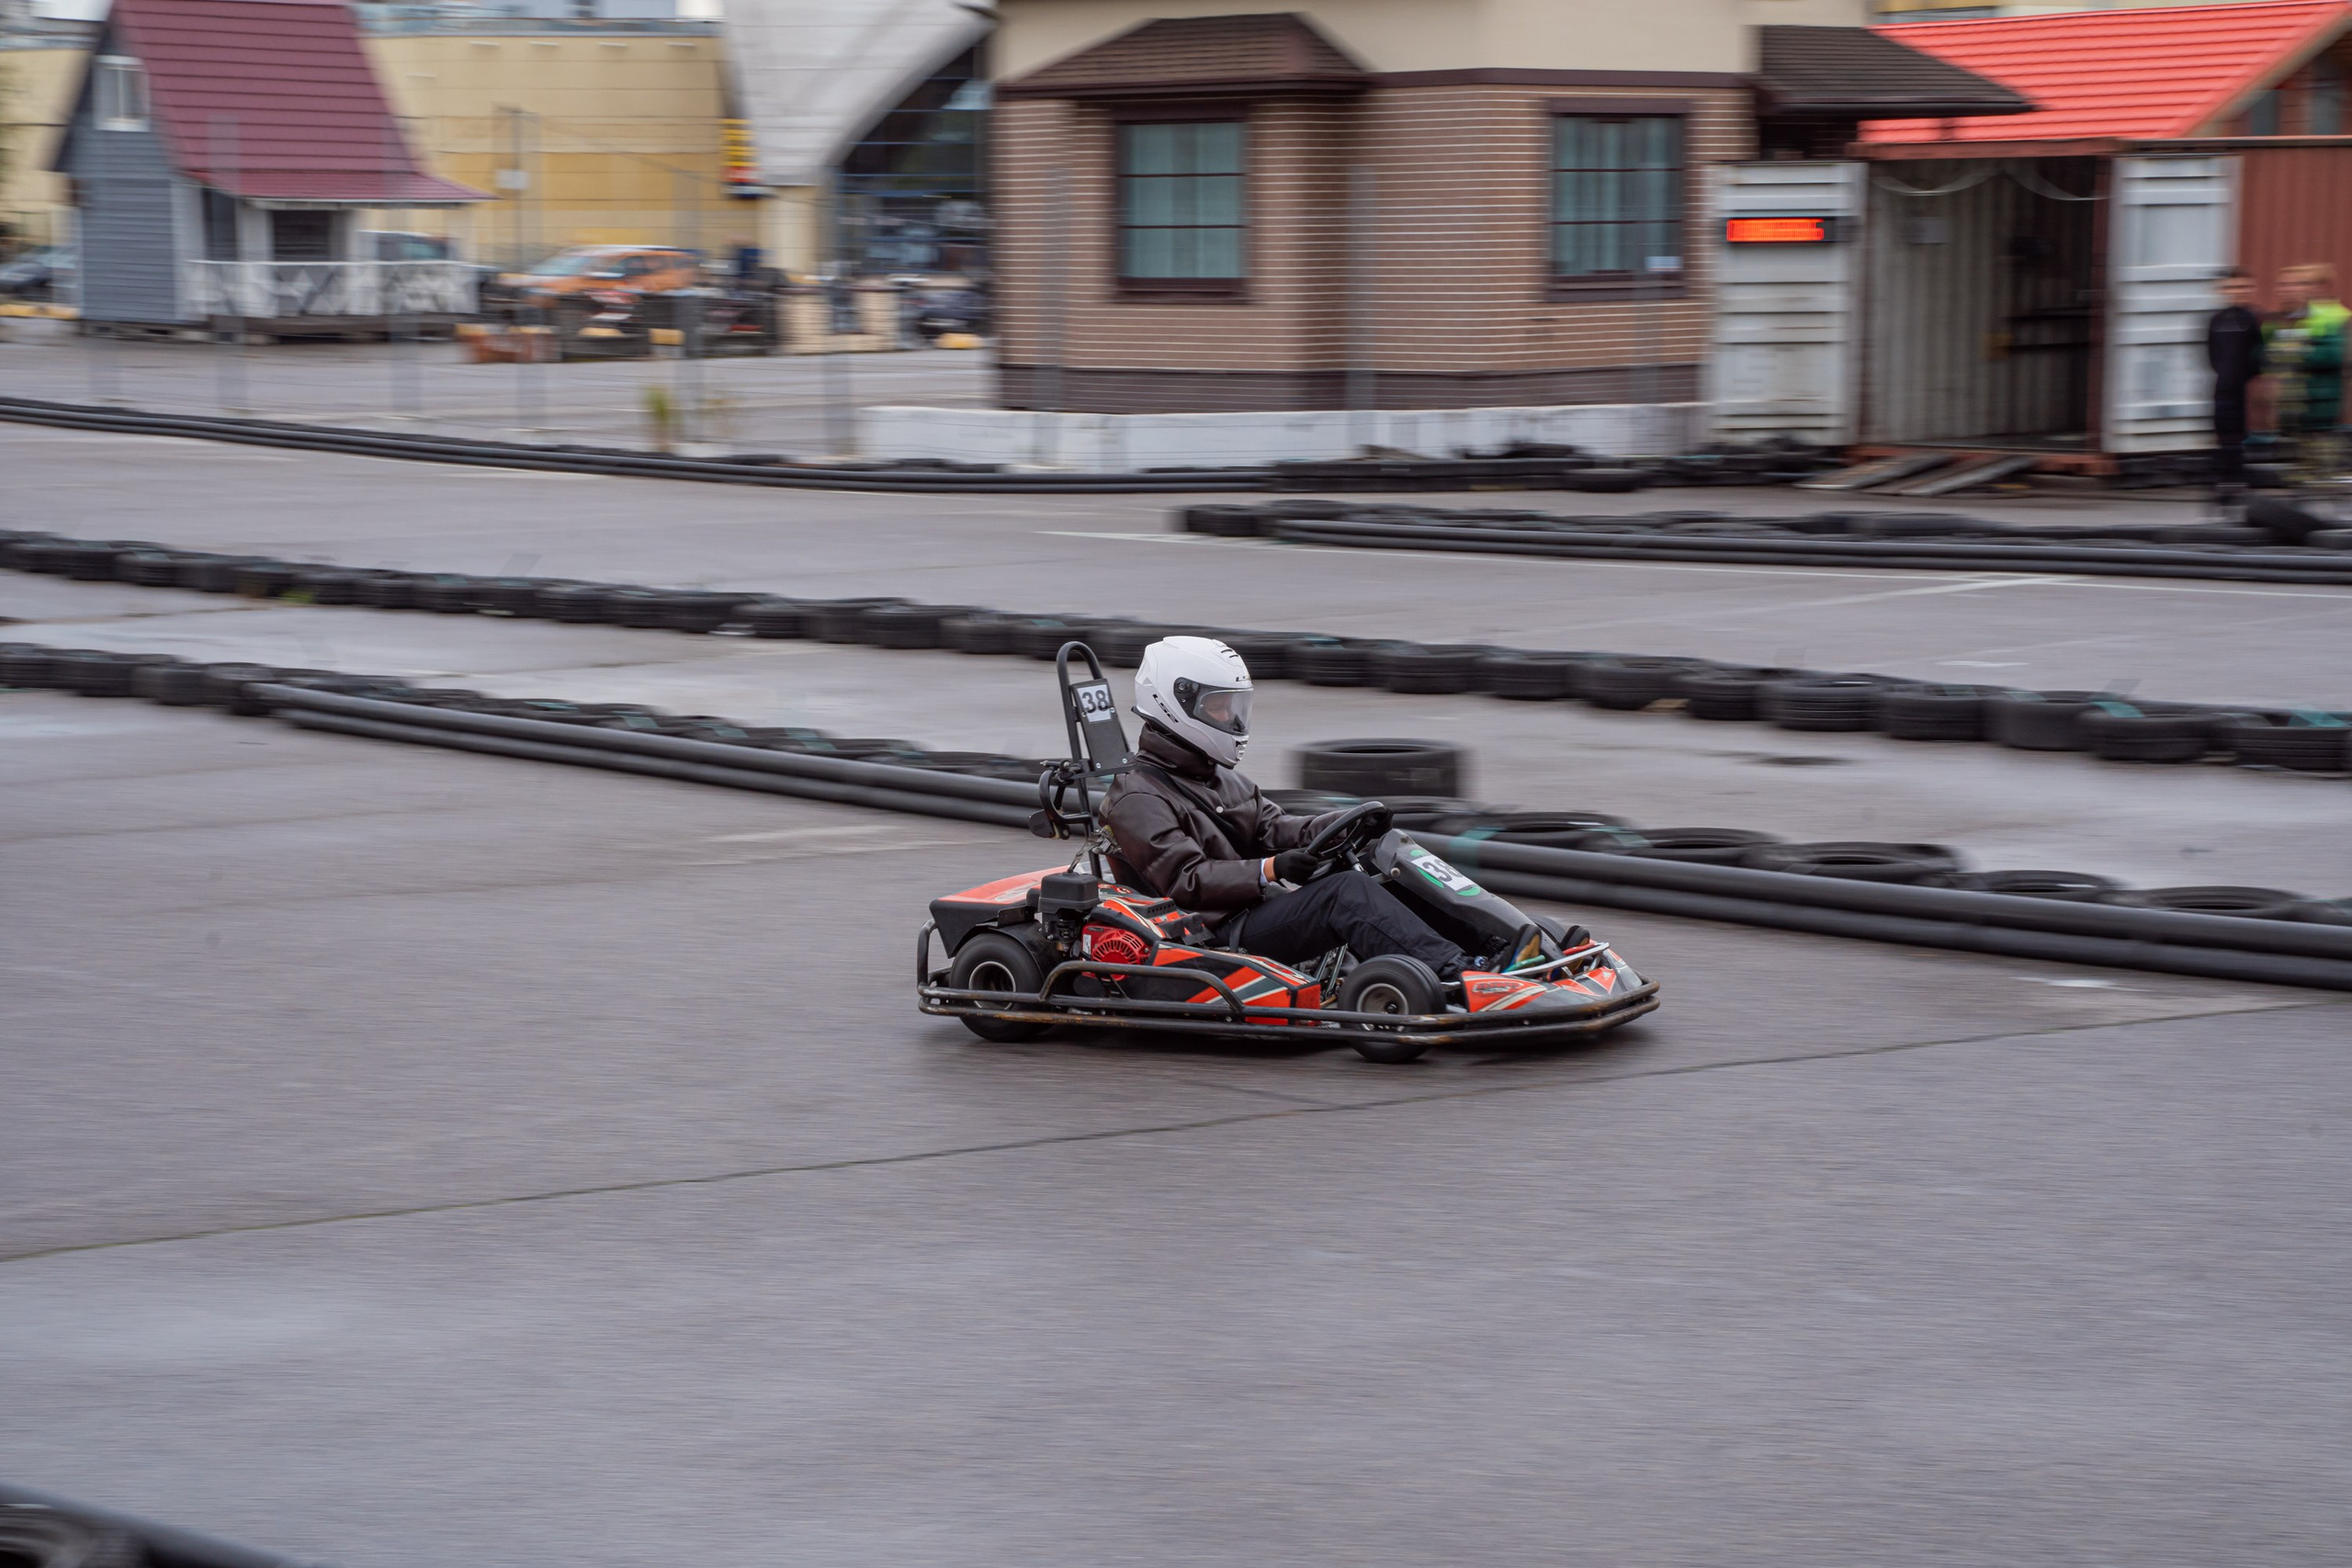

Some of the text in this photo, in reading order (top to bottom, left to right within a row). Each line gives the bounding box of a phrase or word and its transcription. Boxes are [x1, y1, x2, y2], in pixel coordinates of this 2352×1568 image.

[1082, 690, 1109, 713] 38
[1152, 694, 1179, 724] LS2
[1422, 859, 1464, 882] 38
